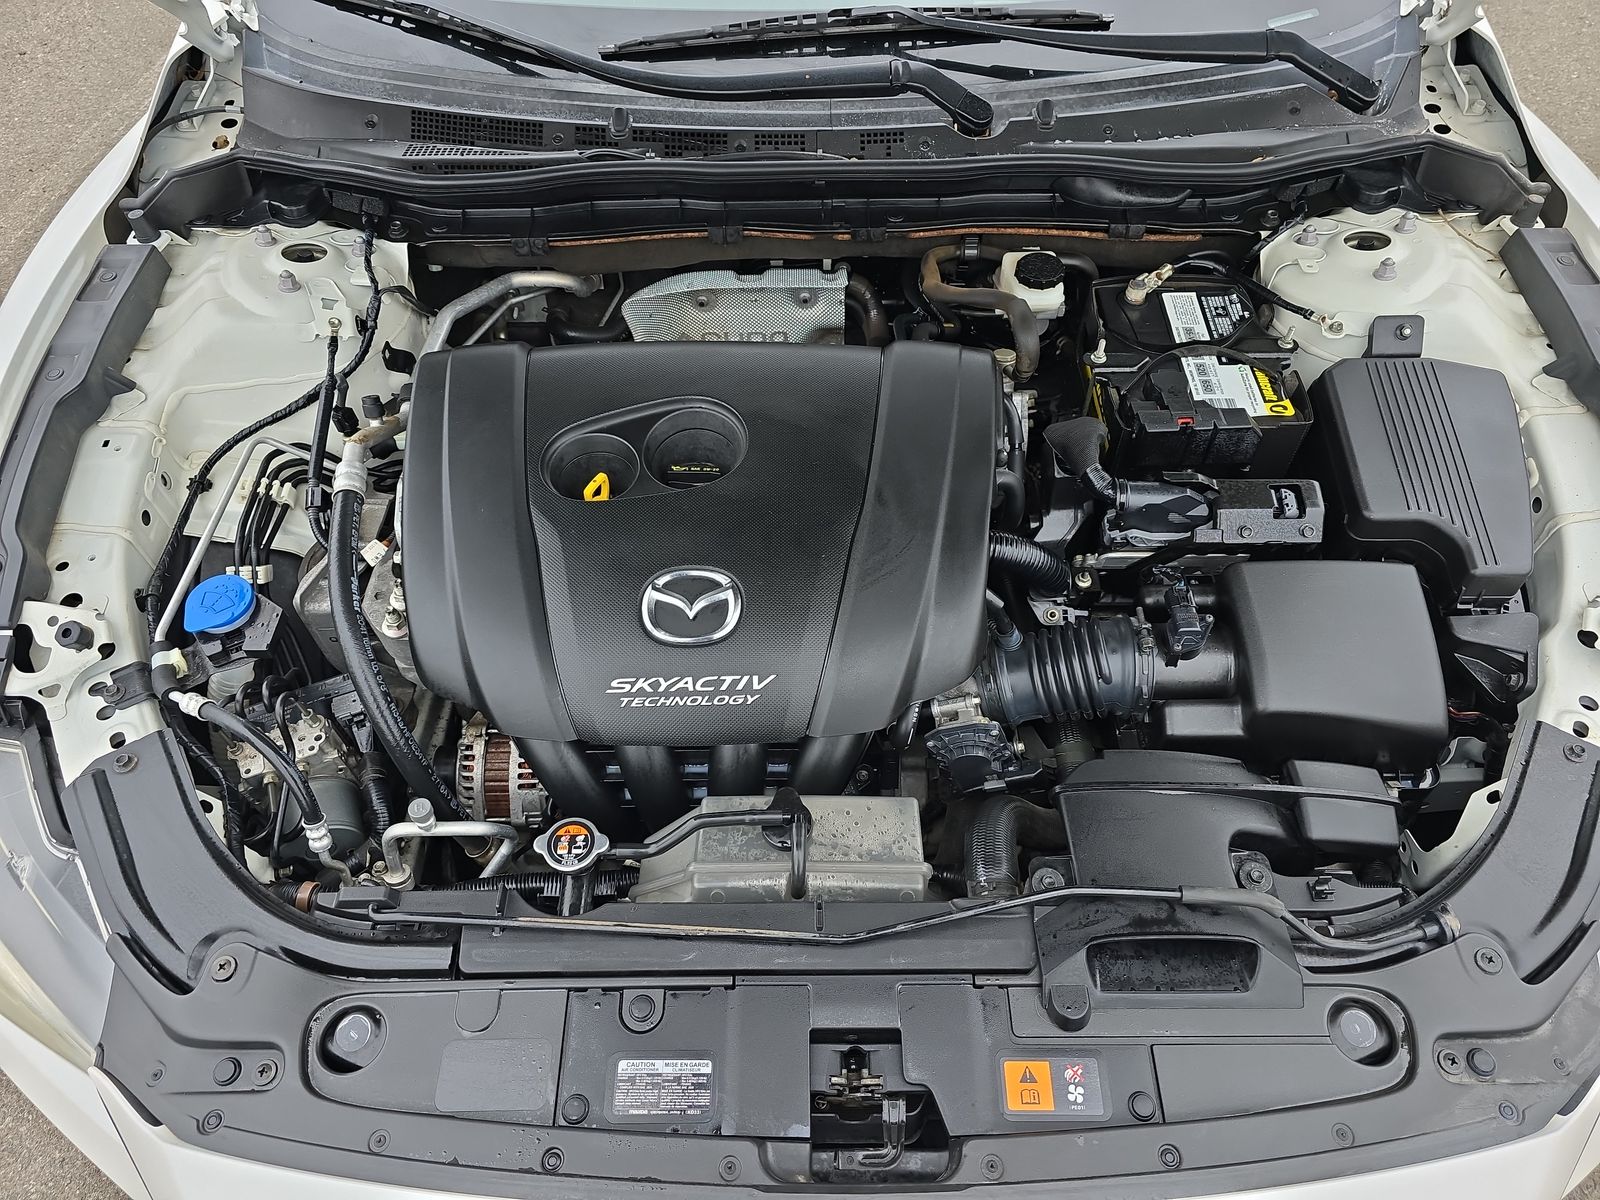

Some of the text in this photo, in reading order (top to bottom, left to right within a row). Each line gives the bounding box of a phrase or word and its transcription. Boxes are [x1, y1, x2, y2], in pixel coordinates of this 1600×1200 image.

[1195, 363, 1213, 394] 520 650
[605, 674, 778, 694] SKYACTIV
[619, 694, 762, 708] TECHNOLOGY
